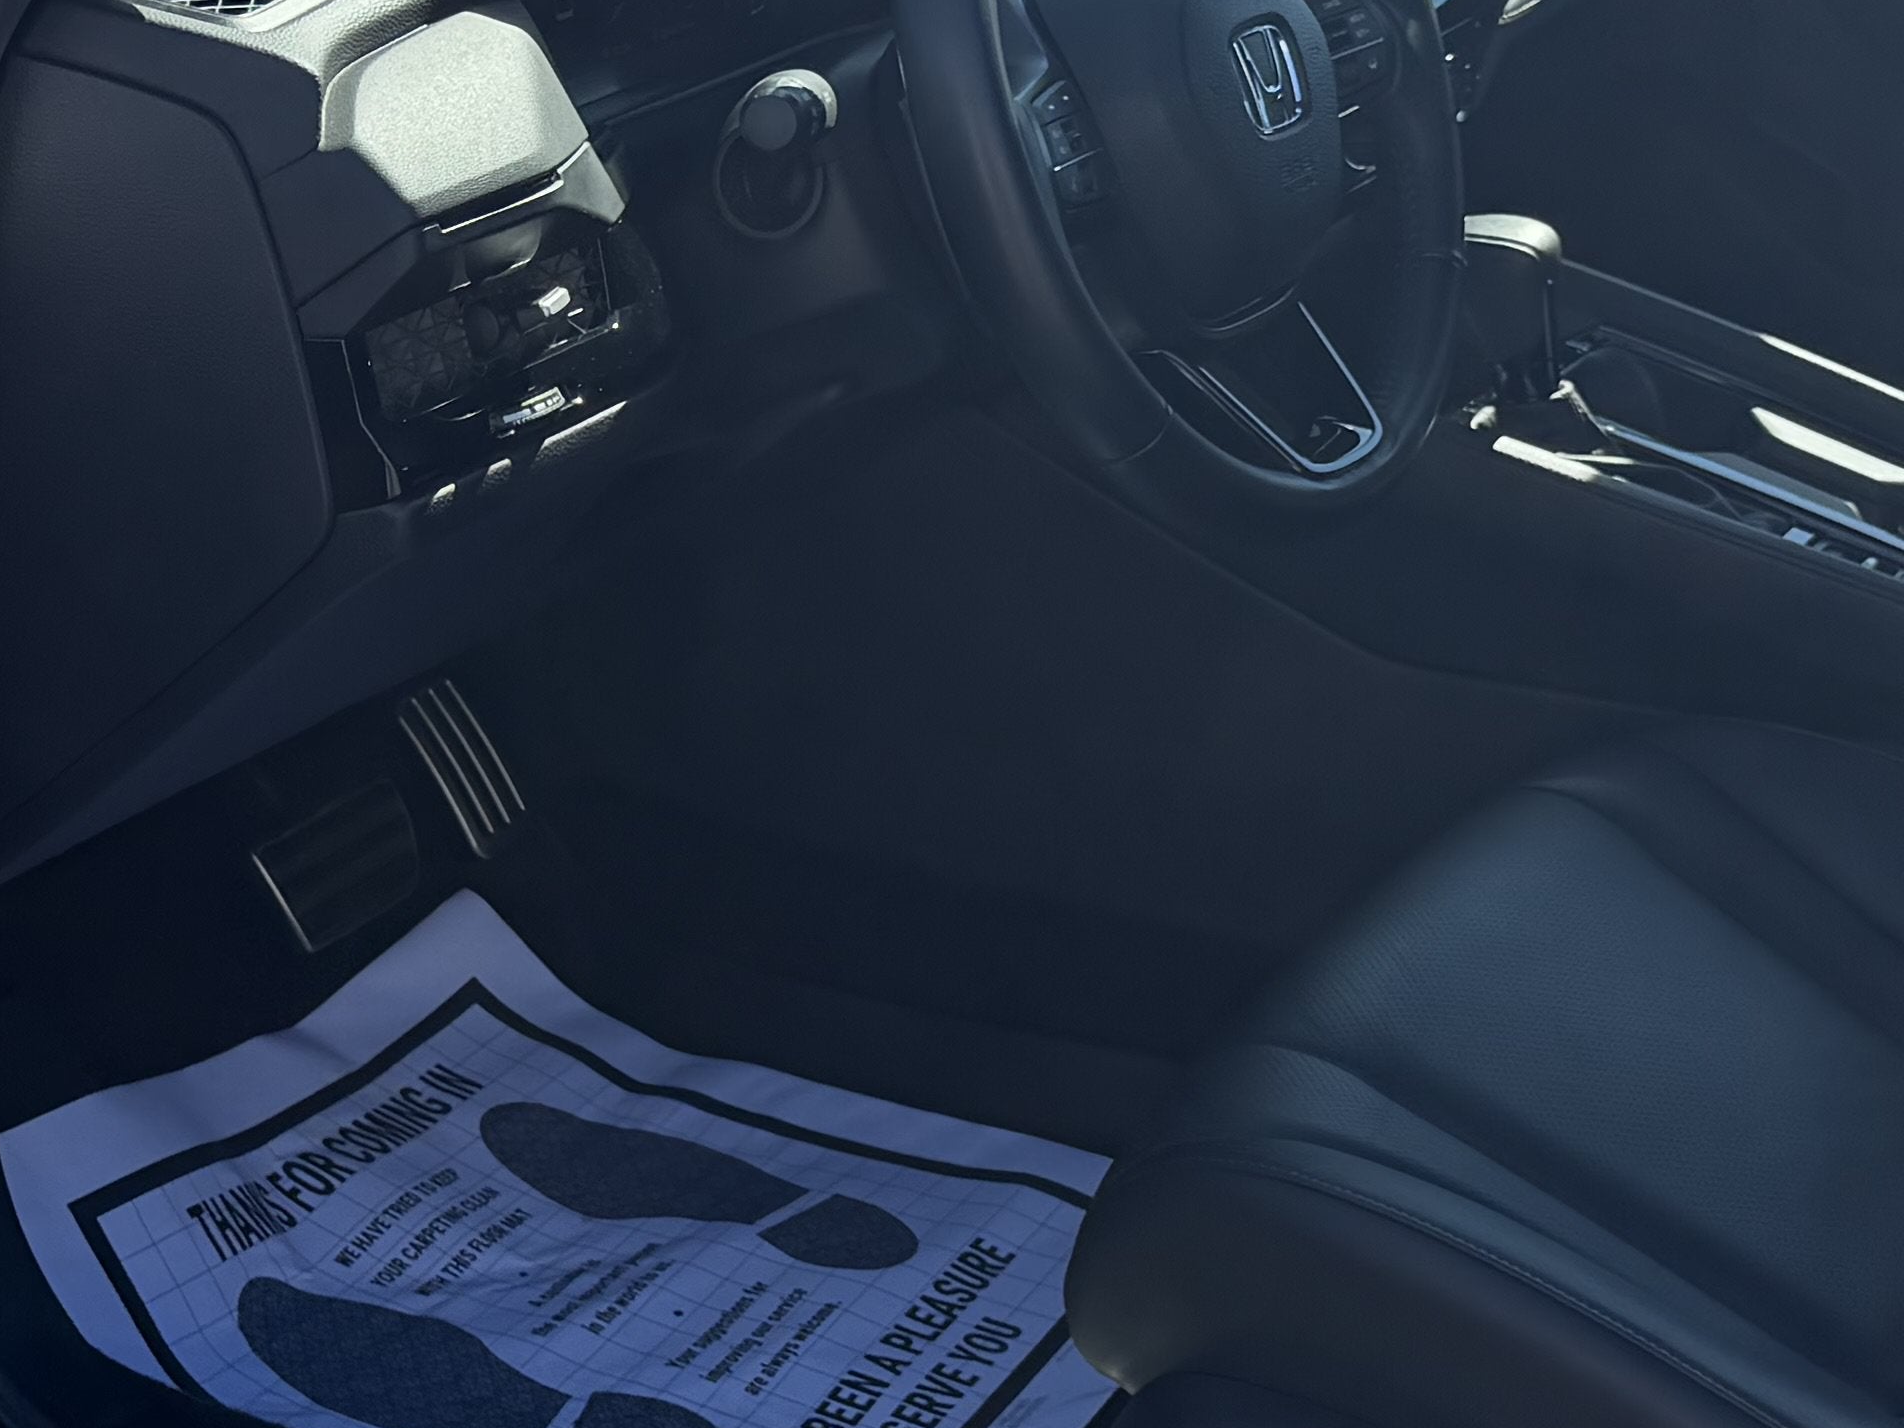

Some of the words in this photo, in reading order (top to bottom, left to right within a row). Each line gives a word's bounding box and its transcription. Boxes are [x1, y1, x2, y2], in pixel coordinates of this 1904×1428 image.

[267, 1151, 356, 1212] FOR
[322, 1086, 452, 1164] COMING
[420, 1063, 484, 1101] IN
[334, 1246, 362, 1267] WE
[351, 1217, 392, 1253] HAVE
[382, 1192, 422, 1221] TRIED
[413, 1181, 437, 1196] TO
[370, 1257, 411, 1287] YOUR
[401, 1206, 468, 1261] CARPETING
[441, 1249, 477, 1278] THIS
[500, 1208, 534, 1230] MAT
[880, 1237, 1017, 1356] PLEASURE
[665, 1348, 700, 1369] Your
[698, 1337, 764, 1384] improving
[768, 1287, 808, 1322] service
[744, 1376, 769, 1396] are
[760, 1342, 801, 1378] always
[864, 1353, 912, 1376] A
[952, 1316, 1022, 1367] YOU
